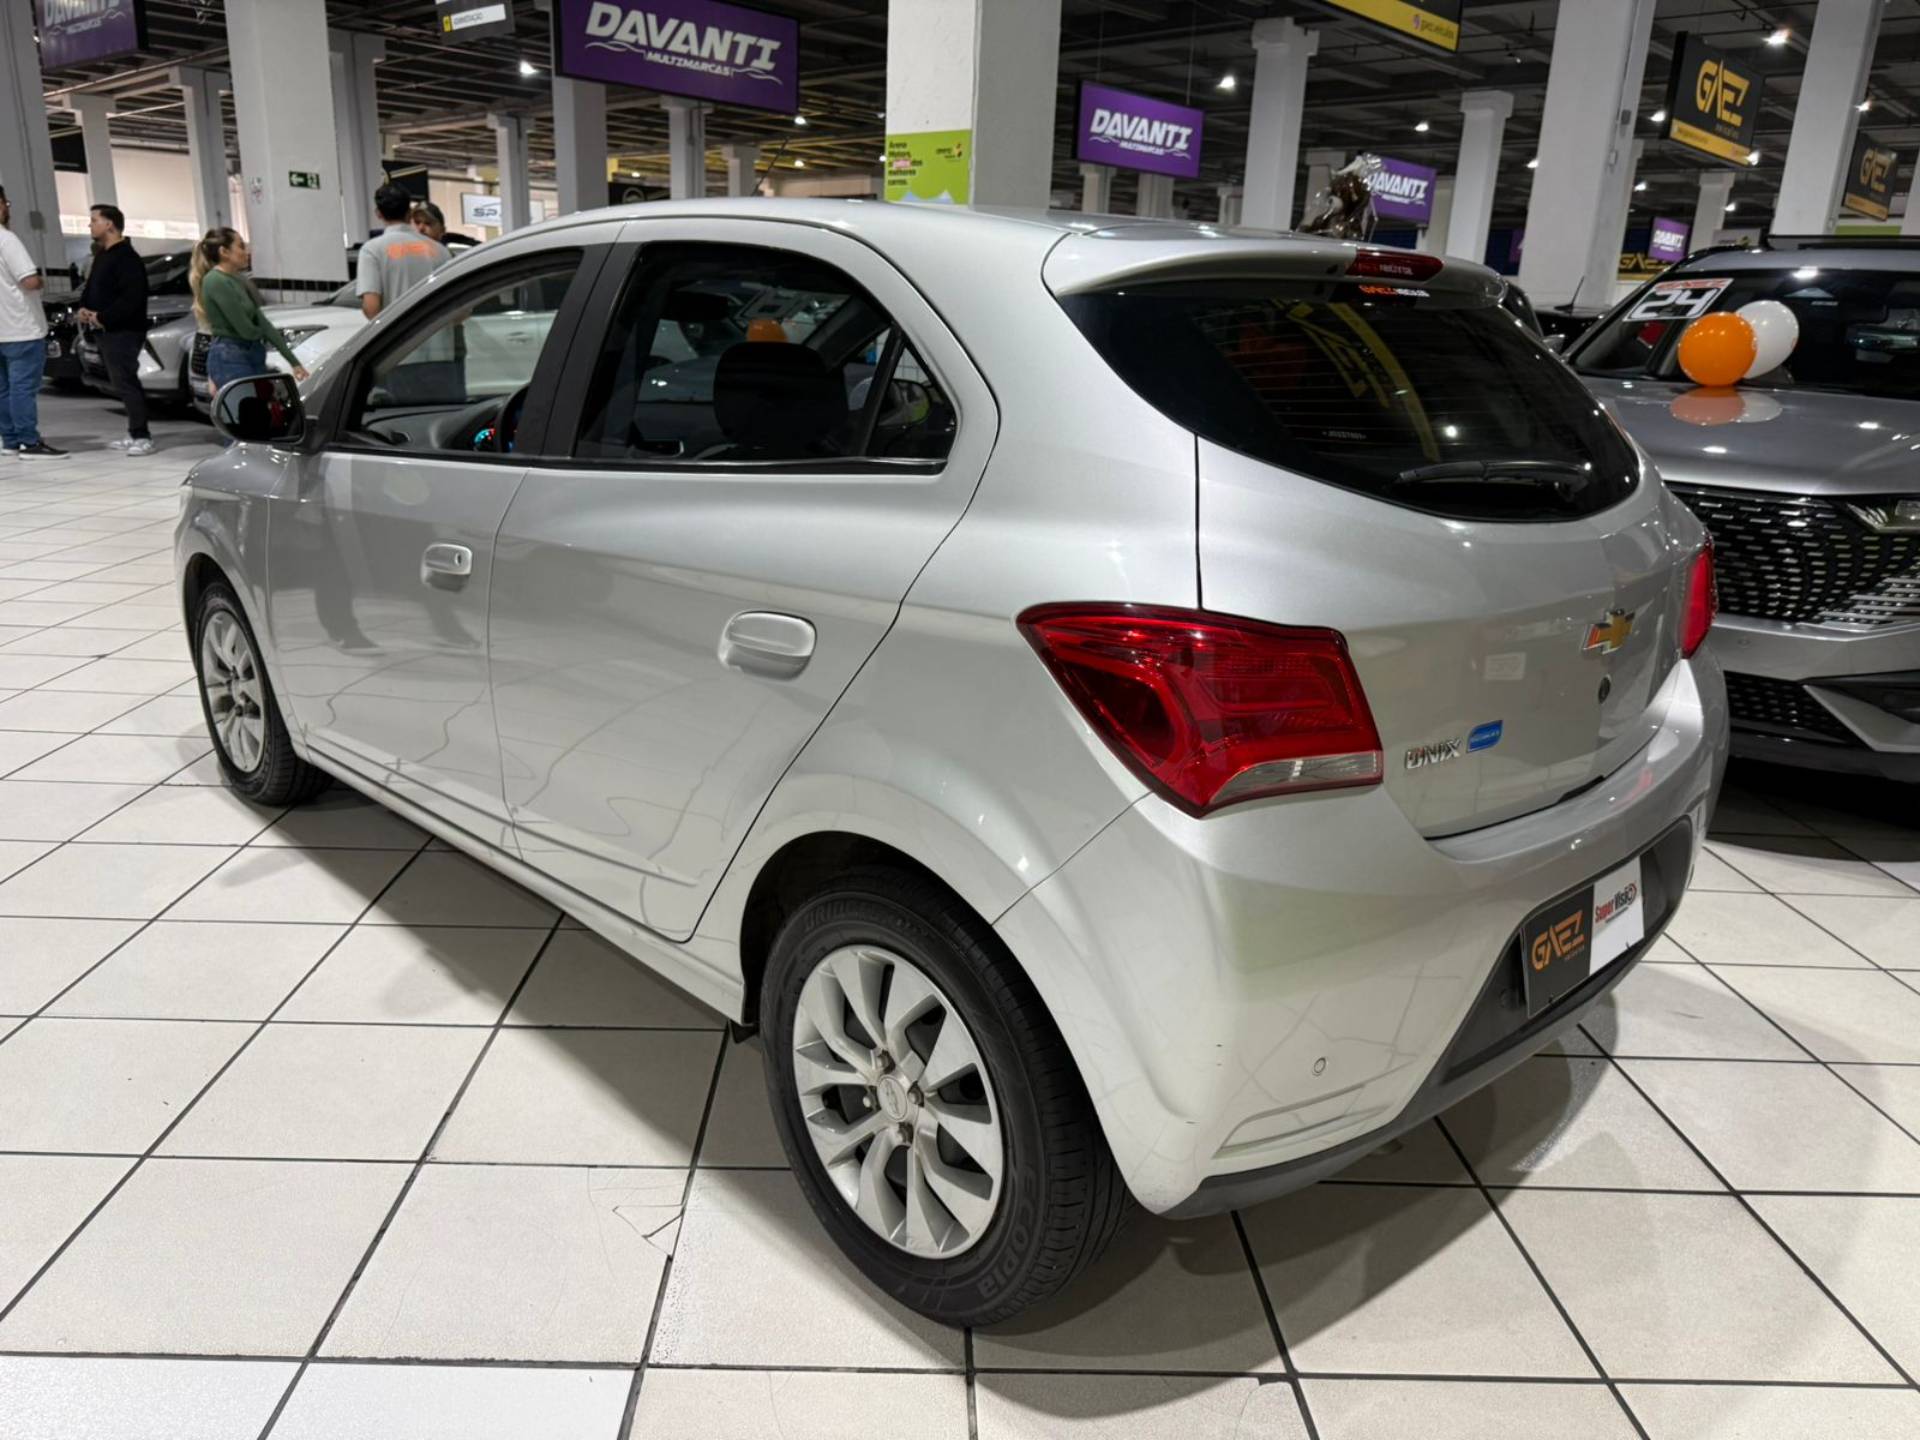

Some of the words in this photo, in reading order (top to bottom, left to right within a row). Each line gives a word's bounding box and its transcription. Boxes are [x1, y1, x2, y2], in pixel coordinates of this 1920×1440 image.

[585, 1, 782, 70] DAVANTI
[647, 51, 731, 77] MULTIMARCAS
[1090, 108, 1193, 150] DAVANTI
[1630, 288, 1719, 318] 24
[1404, 737, 1463, 769] ONIX
